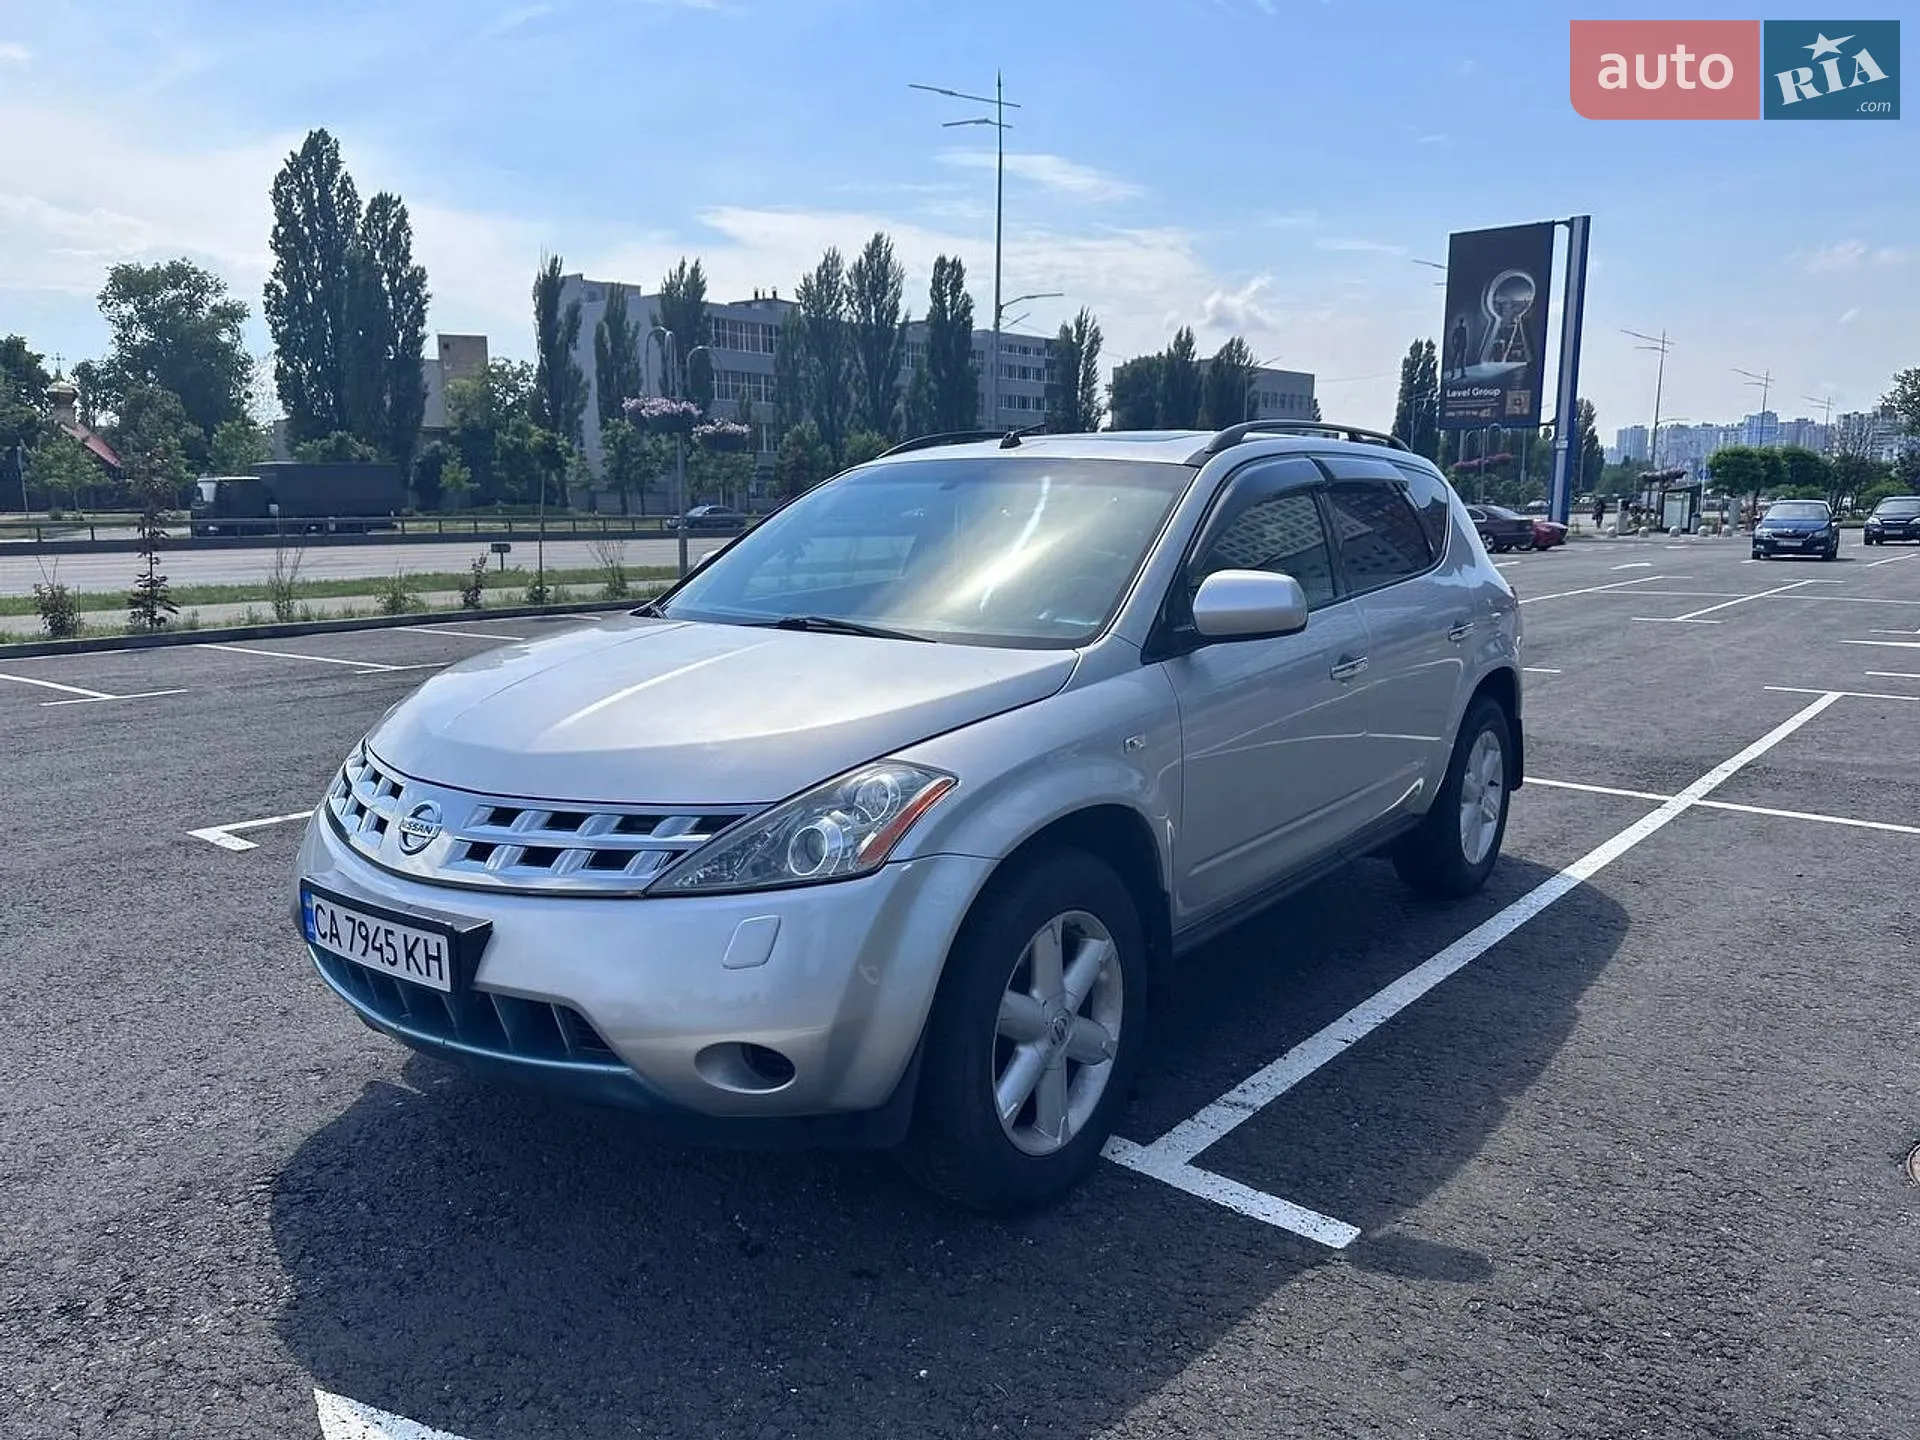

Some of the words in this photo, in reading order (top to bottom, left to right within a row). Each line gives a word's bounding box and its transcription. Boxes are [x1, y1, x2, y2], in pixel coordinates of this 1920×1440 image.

[1446, 388, 1470, 397] Level
[1472, 387, 1501, 397] Group
[402, 820, 436, 835] SSAN
[315, 904, 342, 948] CA
[345, 915, 398, 966] 7945
[403, 934, 443, 980] KH
